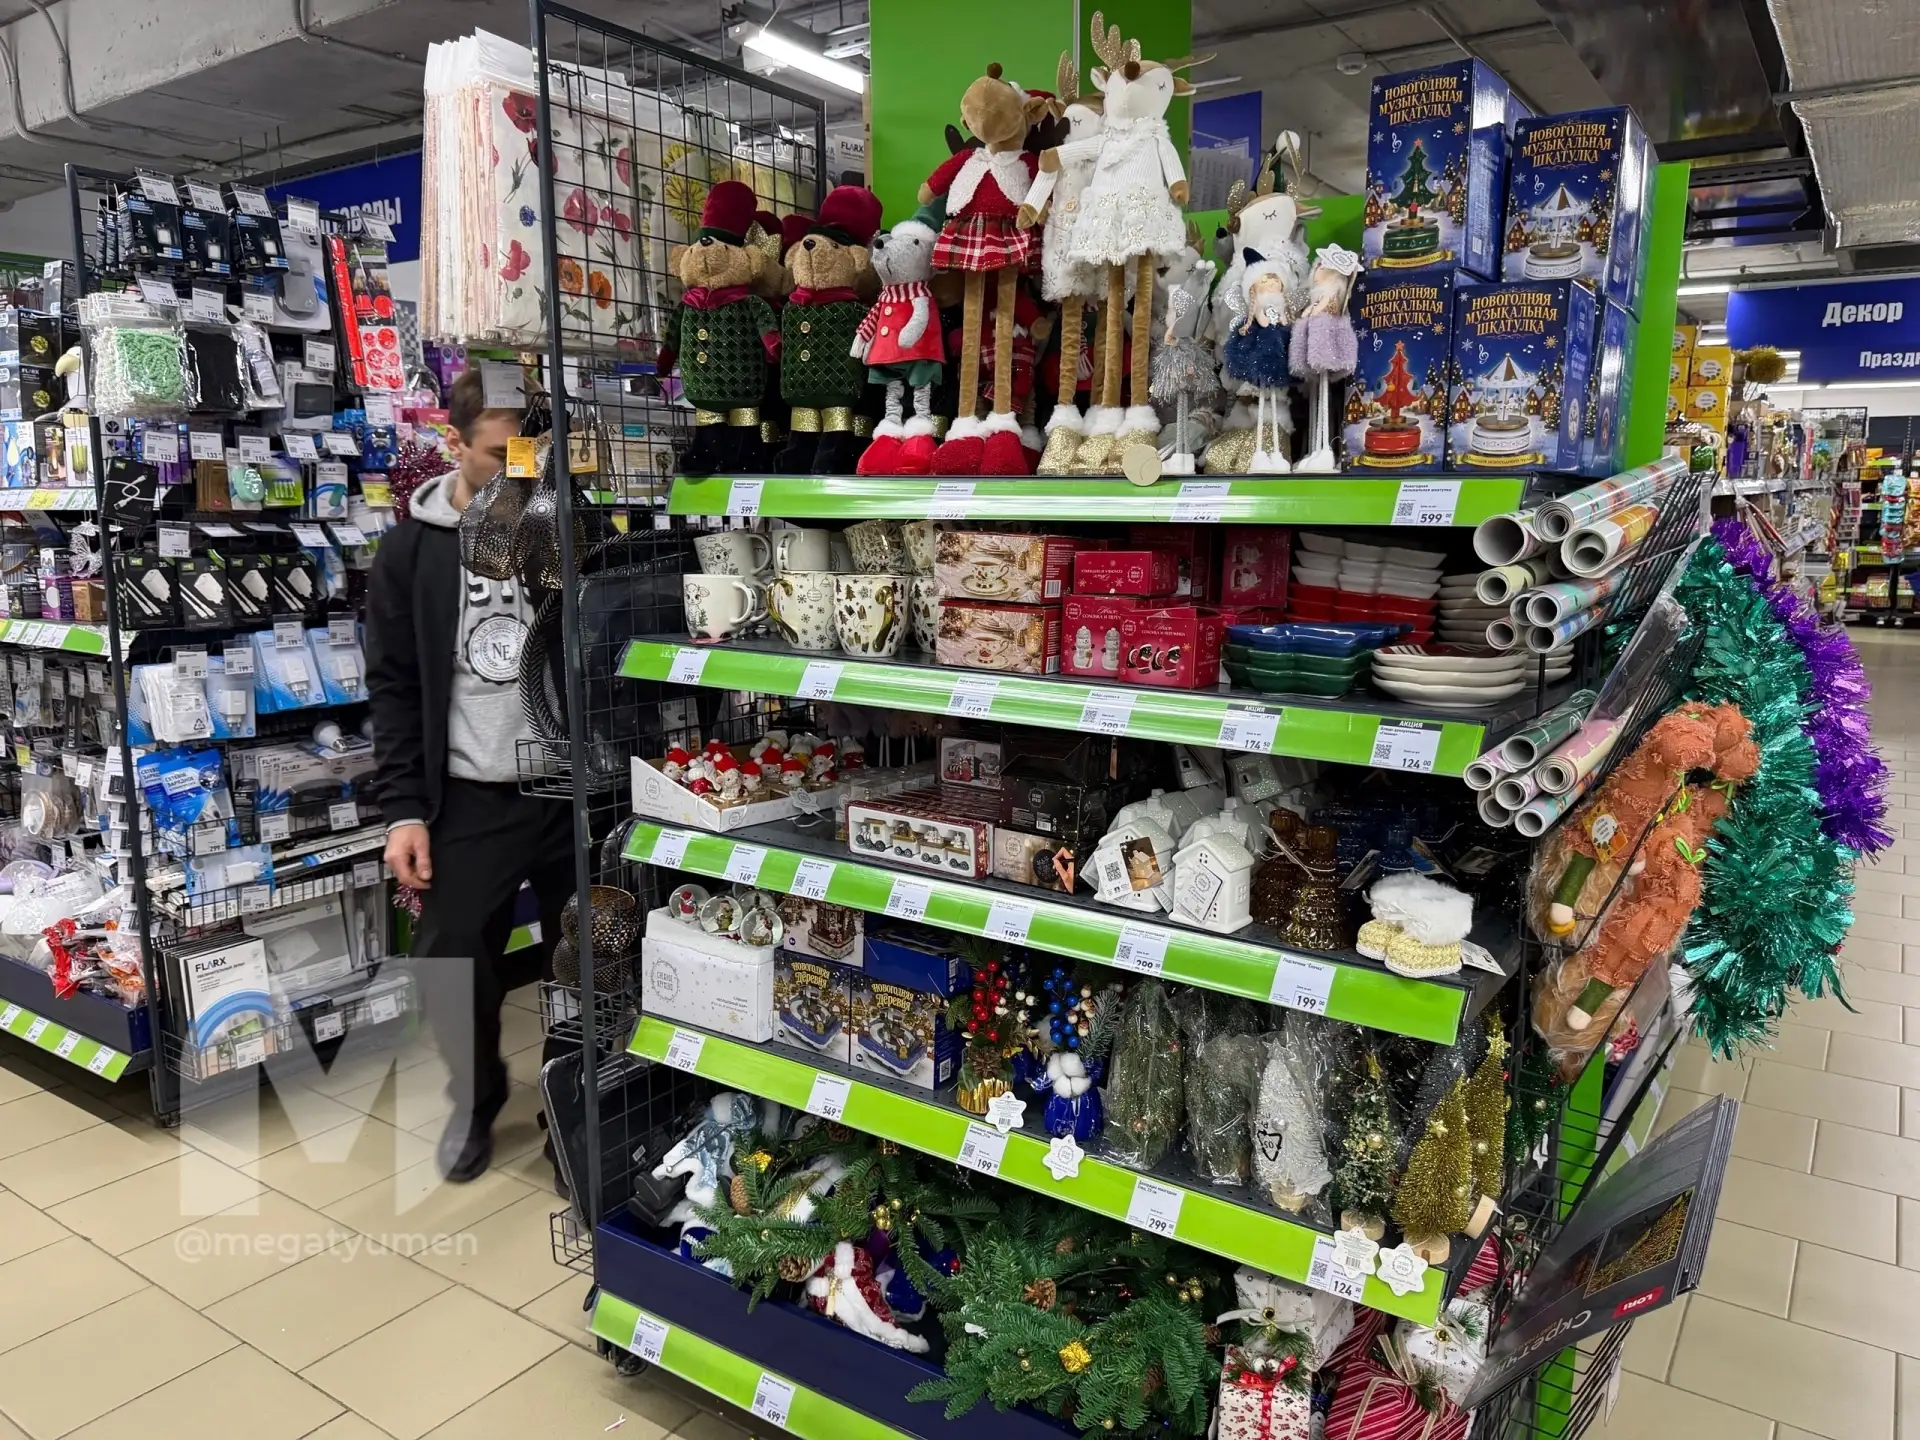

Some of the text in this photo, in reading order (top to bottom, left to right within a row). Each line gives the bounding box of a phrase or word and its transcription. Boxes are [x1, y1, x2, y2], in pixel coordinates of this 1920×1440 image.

[1385, 76, 1457, 99] НОВОГОДНЯЯ
[1379, 90, 1463, 116] МУЗЫКАЛЬНАЯ
[1389, 104, 1452, 125] ШКАТУЛКА
[1529, 124, 1606, 144] НОВОГОДНЯЯ
[1522, 138, 1611, 158] МУЗЫКАЛЬНАЯ
[1533, 149, 1599, 167] ШКАТУЛКА
[1366, 286, 1438, 304] НОВОГОДНЯЯ
[1472, 292, 1552, 308] НОВОГОДНЯЯ
[1360, 301, 1444, 319] МУЗЫКАЛЬНАЯ
[1465, 306, 1557, 324] МУЗЫКАЛЬНАЯ
[1822, 301, 1903, 327] Декор
[1371, 313, 1432, 329] ШКАТУЛКА
[1477, 320, 1544, 336] ШКАТУЛКА
[741, 506, 752, 514] 599
[1420, 514, 1442, 523] 599
[492, 642, 511, 660] NE
[683, 673, 695, 683] 199
[813, 688, 828, 698] 299
[1245, 740, 1260, 749] 174
[1402, 758, 1420, 769] 124
[319, 846, 351, 860] FLARX
[664, 856, 676, 866] 124
[739, 871, 750, 882] 149
[807, 887, 819, 897] 116
[195, 957, 227, 972] FLARX
[1297, 995, 1316, 1009] 199
[678, 1058, 690, 1069] 229
[822, 1105, 836, 1116] 549
[977, 1159, 992, 1170] 199
[1149, 1218, 1166, 1231] 299
[1334, 1280, 1352, 1296] 124
[1623, 1293, 1653, 1311] LORI
[644, 1348, 655, 1359] 599
[767, 1410, 780, 1422] 499
